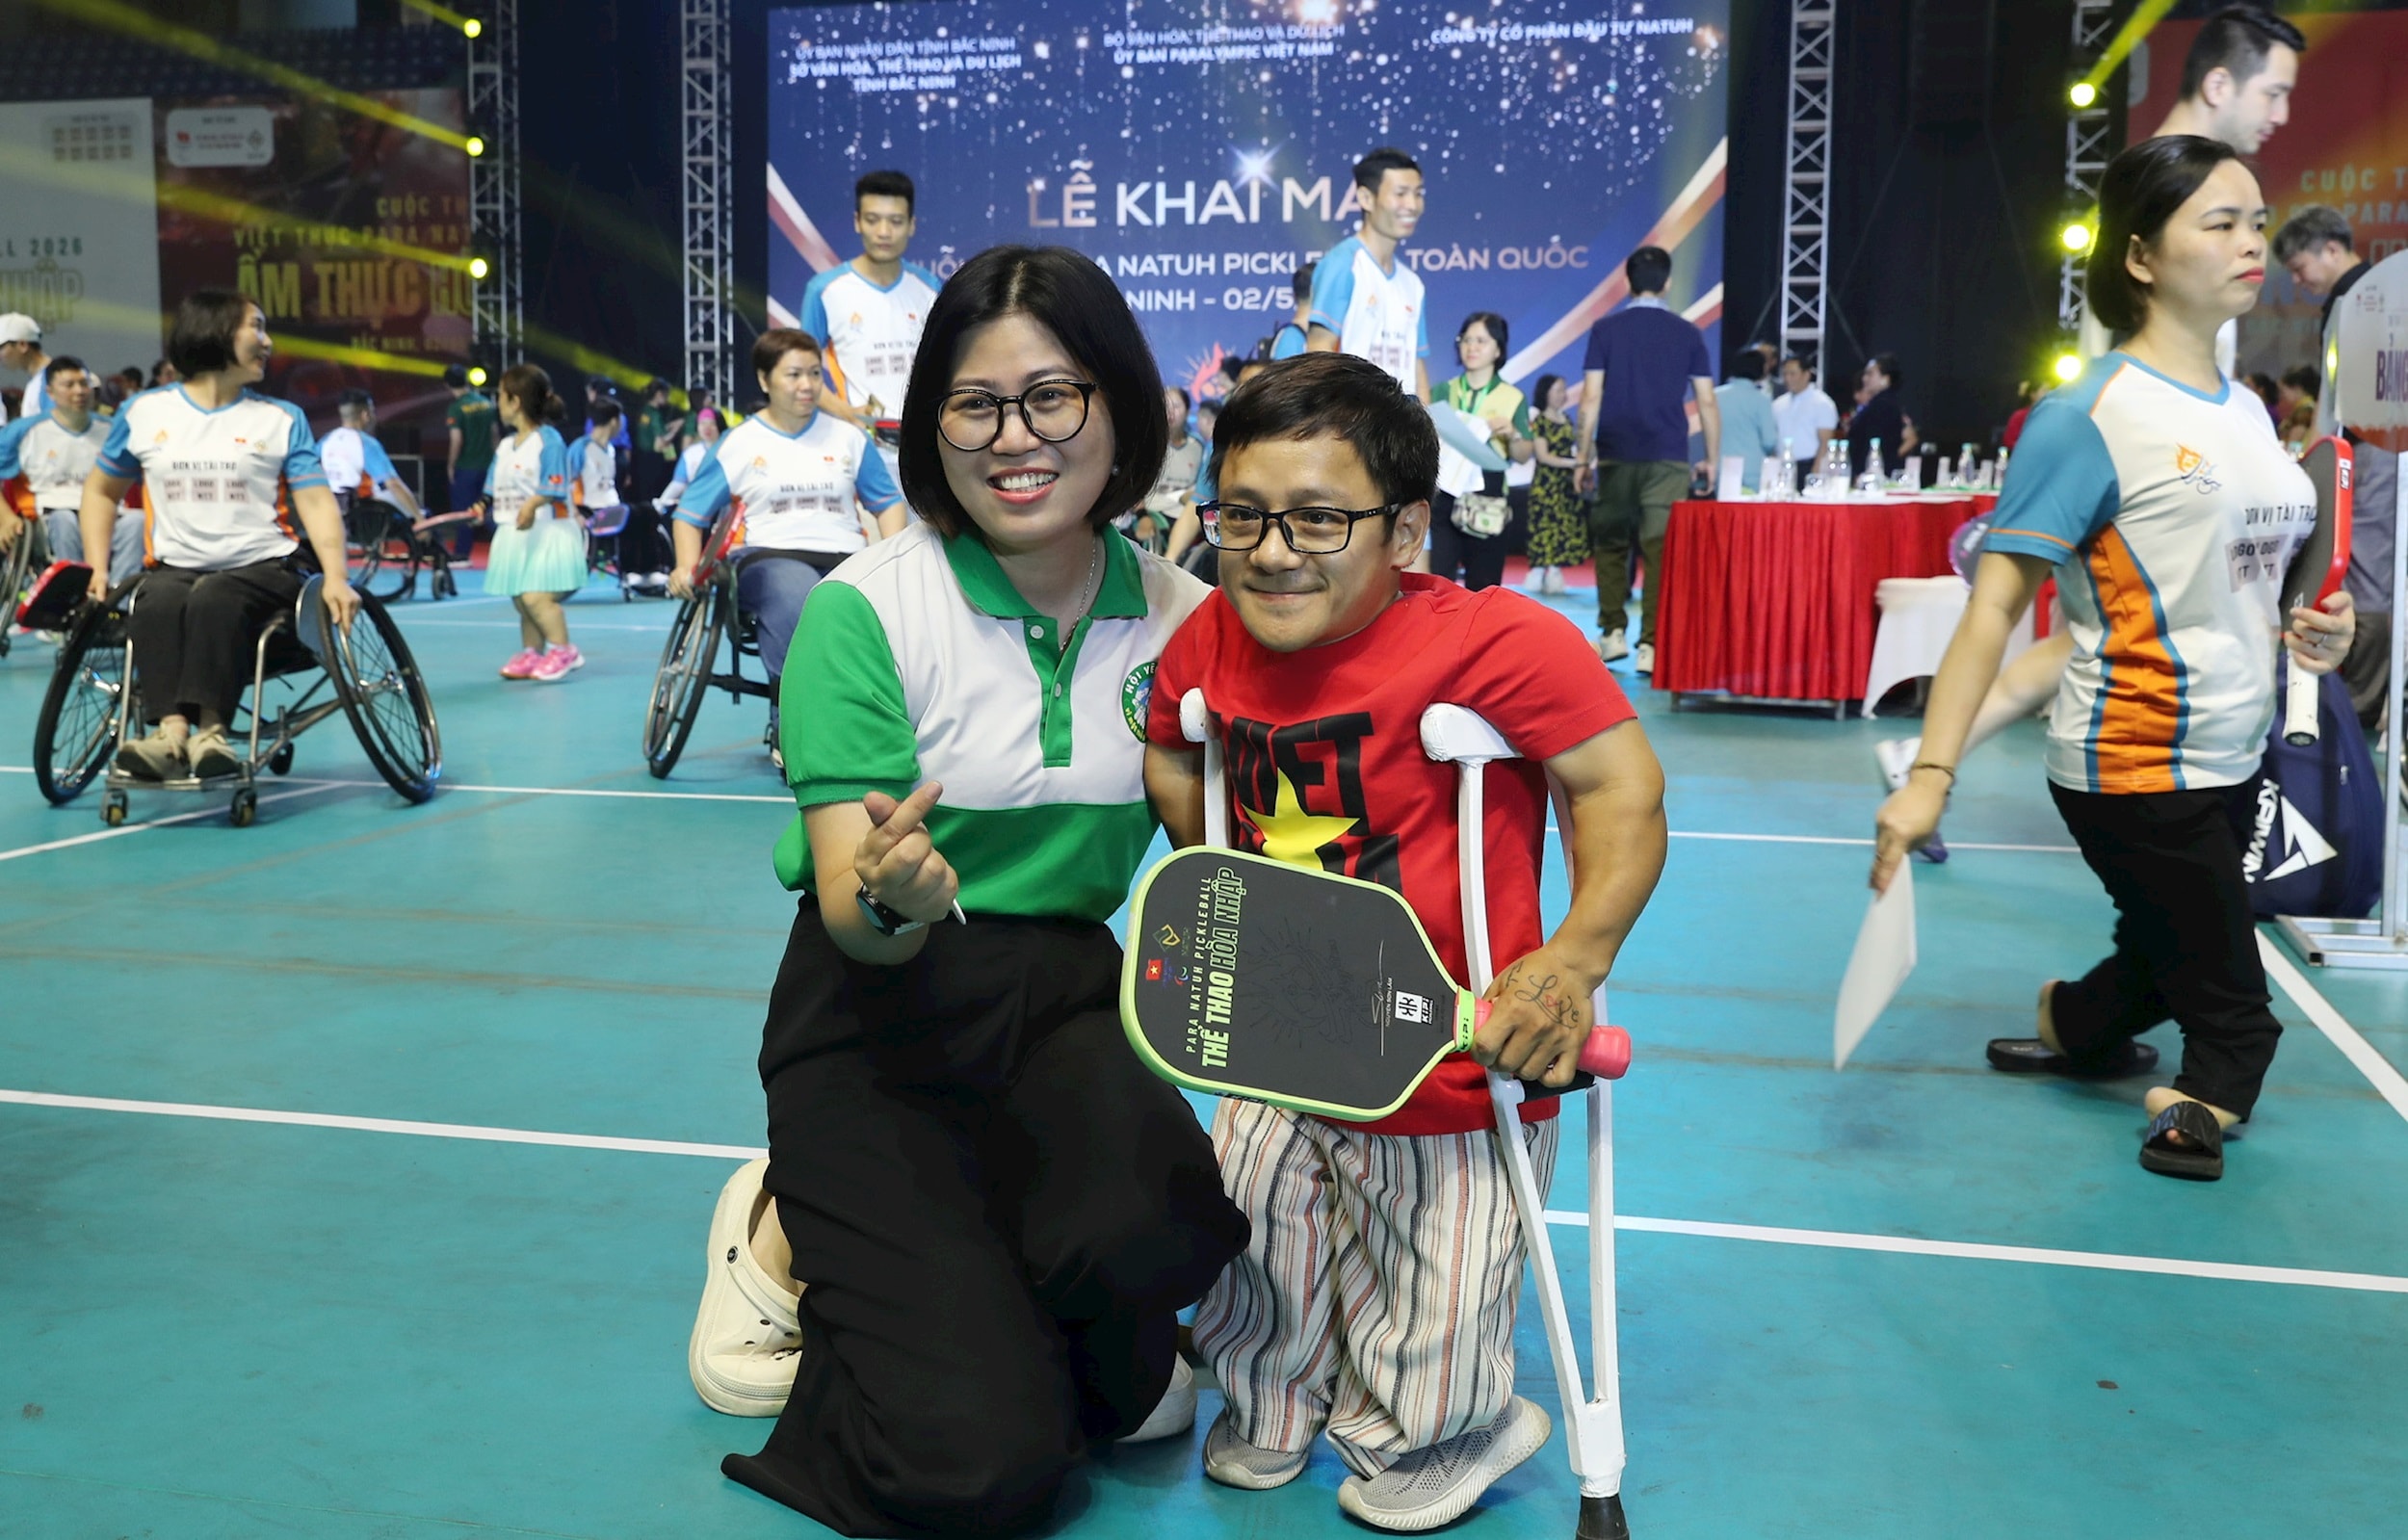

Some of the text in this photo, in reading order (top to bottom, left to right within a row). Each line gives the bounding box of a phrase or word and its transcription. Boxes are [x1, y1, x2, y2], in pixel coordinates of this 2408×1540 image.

[1287, 25, 1307, 39] DU
[1430, 26, 1476, 44] CÔNG
[1476, 26, 1499, 41] TY
[1610, 19, 1635, 36] TƯ
[1636, 18, 1693, 35] NATUH
[815, 44, 843, 59] BAN
[845, 39, 883, 58] NHÂN
[885, 39, 914, 56] DÂN
[980, 37, 1016, 52] NINH
[1137, 47, 1168, 64] BAN
[1169, 44, 1261, 62] PARALYMPIC
[1263, 41, 1296, 60] VIỆT
[1297, 40, 1334, 57] NAM
[810, 60, 839, 76] VĂN
[965, 55, 986, 69] DU
[918, 74, 956, 90] NINH
[1028, 160, 1096, 227] LỄ
[1117, 176, 1260, 226] KHAI
[2301, 164, 2377, 200] CUỘC
[1118, 252, 1216, 277] NATUH
[1405, 242, 1490, 271] TOÀN
[1498, 234, 1588, 271] QUỐC
[1124, 289, 1196, 311] NINH
[1124, 670, 1142, 694] HỘI
[1185, 876, 1213, 1054] PARA NATUH PICKLEBALL
[1196, 866, 1248, 1069] THỂ THAO HÒA NHẬP
